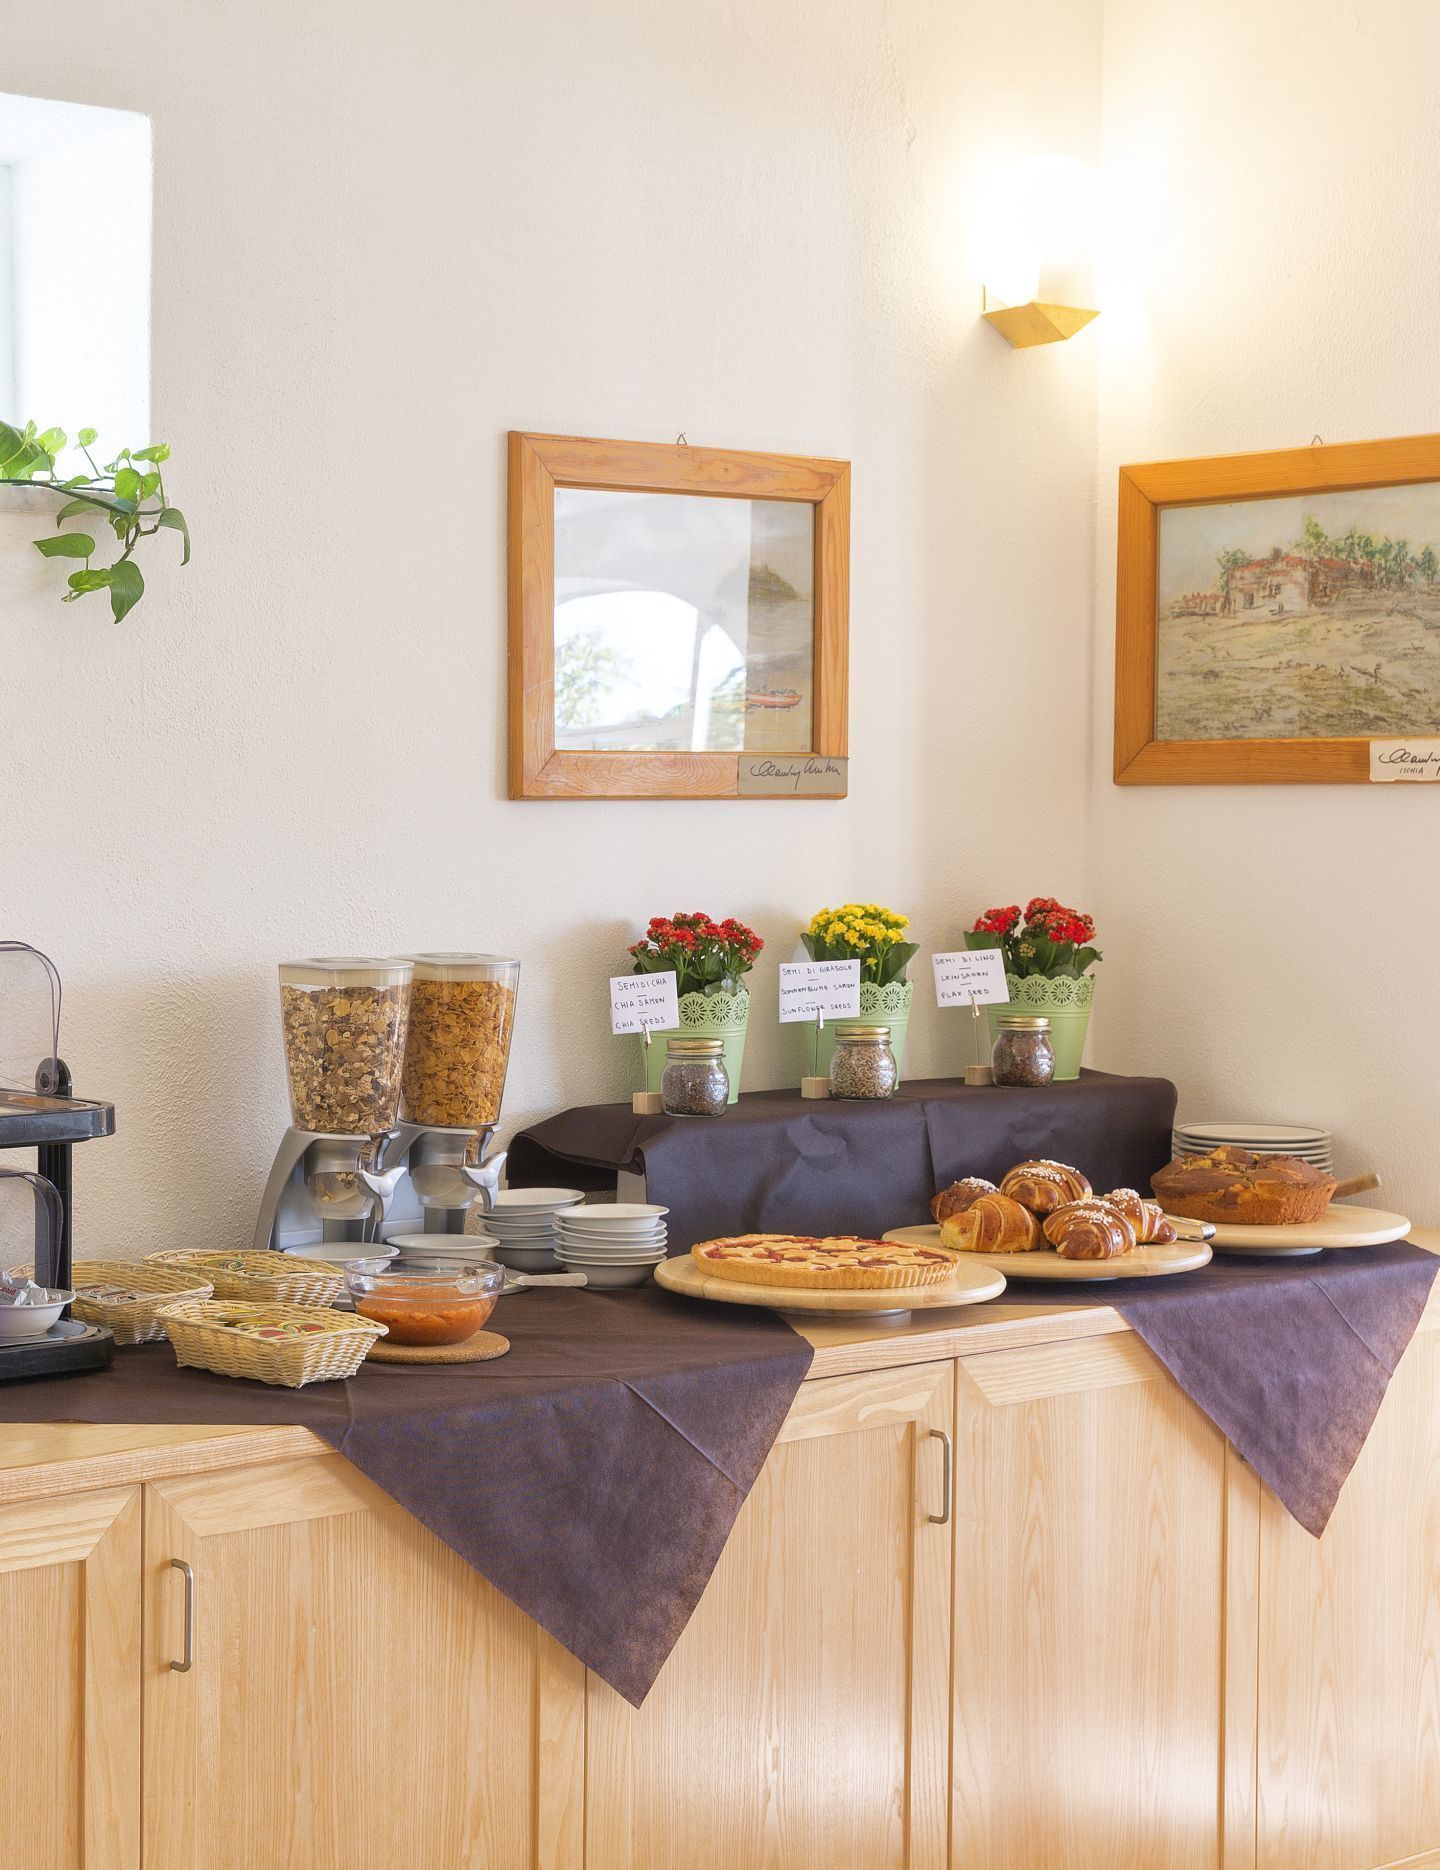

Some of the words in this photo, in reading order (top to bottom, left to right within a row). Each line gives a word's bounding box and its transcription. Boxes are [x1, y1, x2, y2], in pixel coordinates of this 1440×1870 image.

[941, 991, 961, 999] FLAX
[615, 1000, 634, 1010] CHIA
[638, 997, 665, 1006] SAMEN
[615, 1020, 634, 1029] CHIA
[639, 1016, 665, 1025] SEEDS
